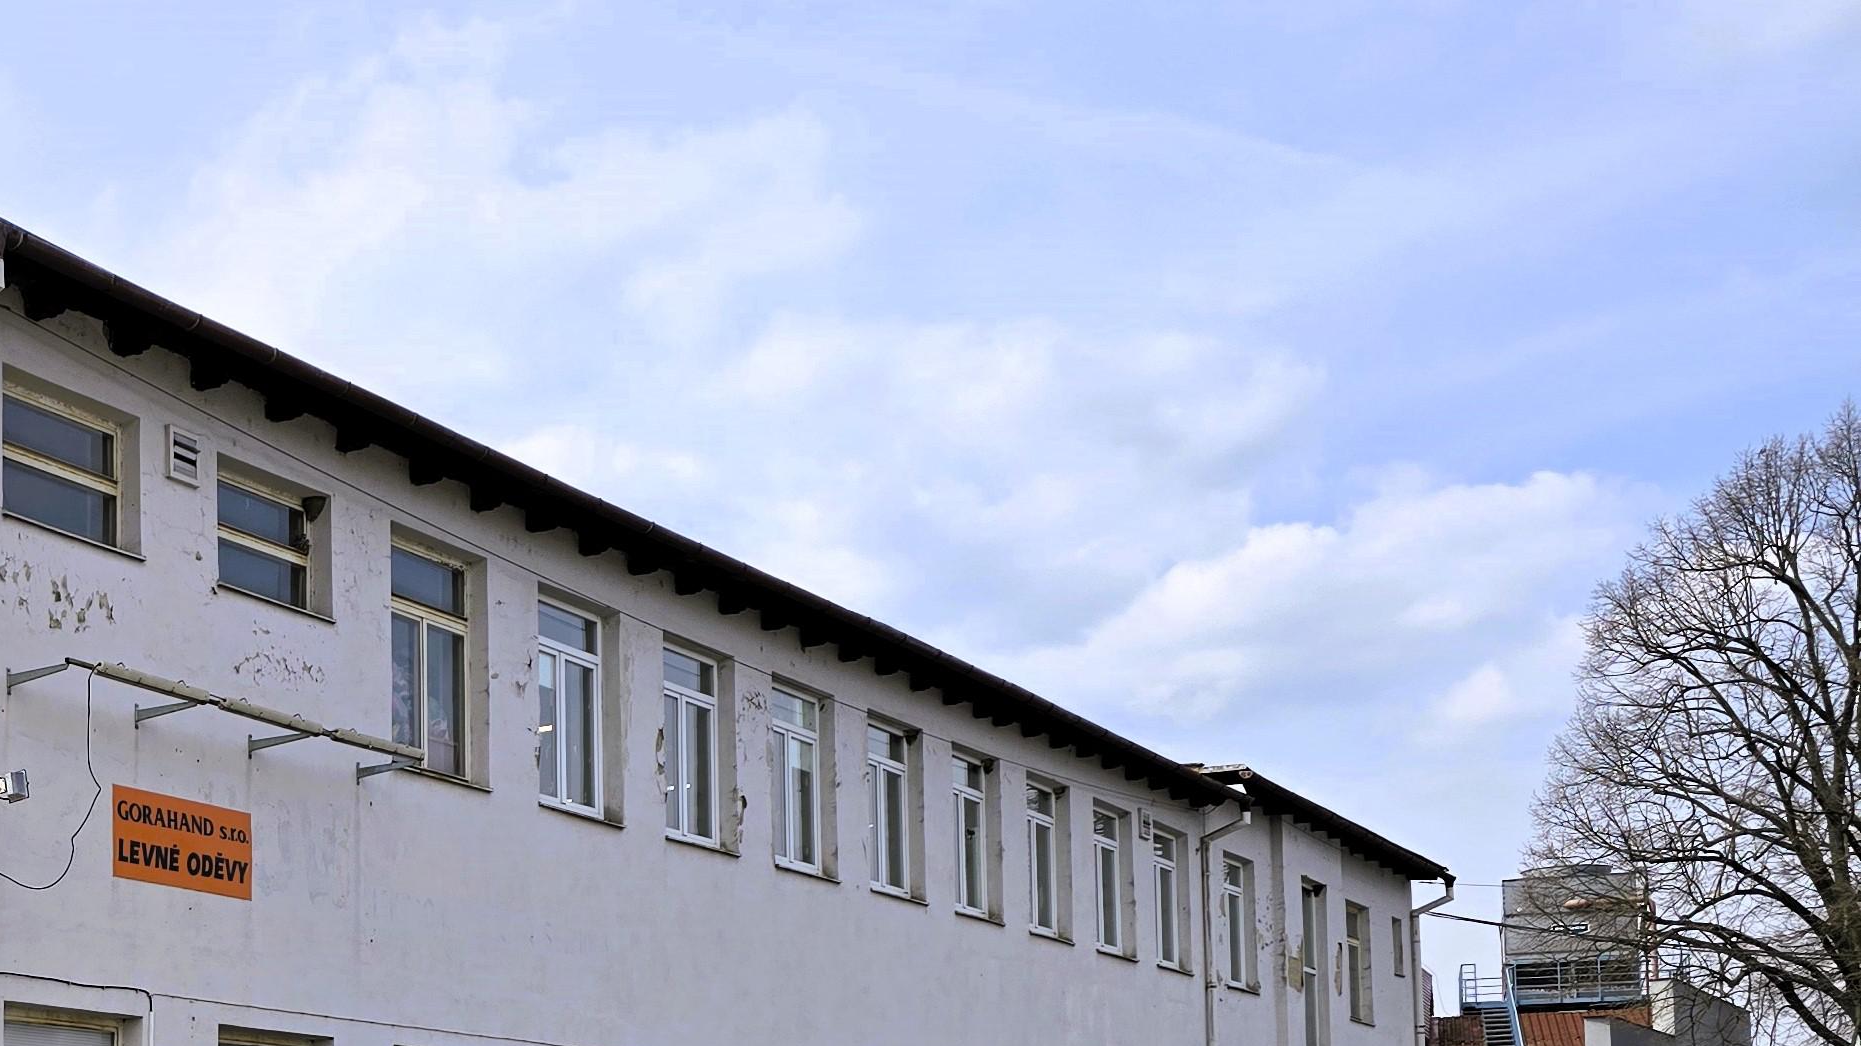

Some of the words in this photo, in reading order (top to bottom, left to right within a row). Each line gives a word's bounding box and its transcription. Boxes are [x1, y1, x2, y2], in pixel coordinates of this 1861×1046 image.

[117, 800, 214, 836] GORAHAND
[219, 825, 249, 844] s.r.o.
[118, 838, 180, 872] LEVNÉ
[187, 851, 248, 884] ODĚVY
